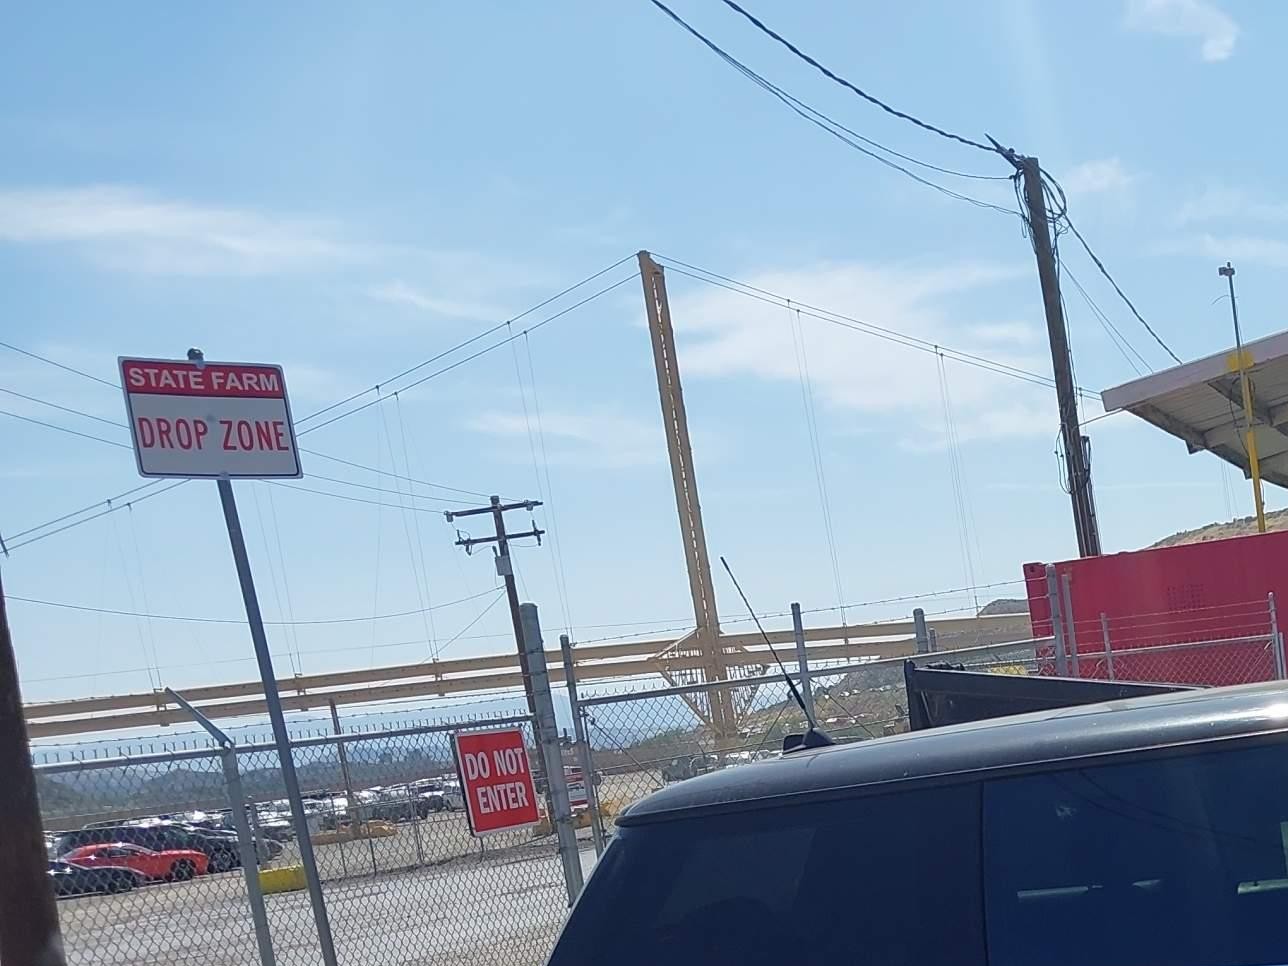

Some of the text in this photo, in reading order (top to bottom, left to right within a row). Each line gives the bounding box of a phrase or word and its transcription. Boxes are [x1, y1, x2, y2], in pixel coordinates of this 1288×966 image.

[129, 368, 279, 391] STATE FARM
[138, 417, 289, 451] DROP ZONE
[464, 748, 525, 781] DO NOT
[477, 782, 529, 814] ENTER
